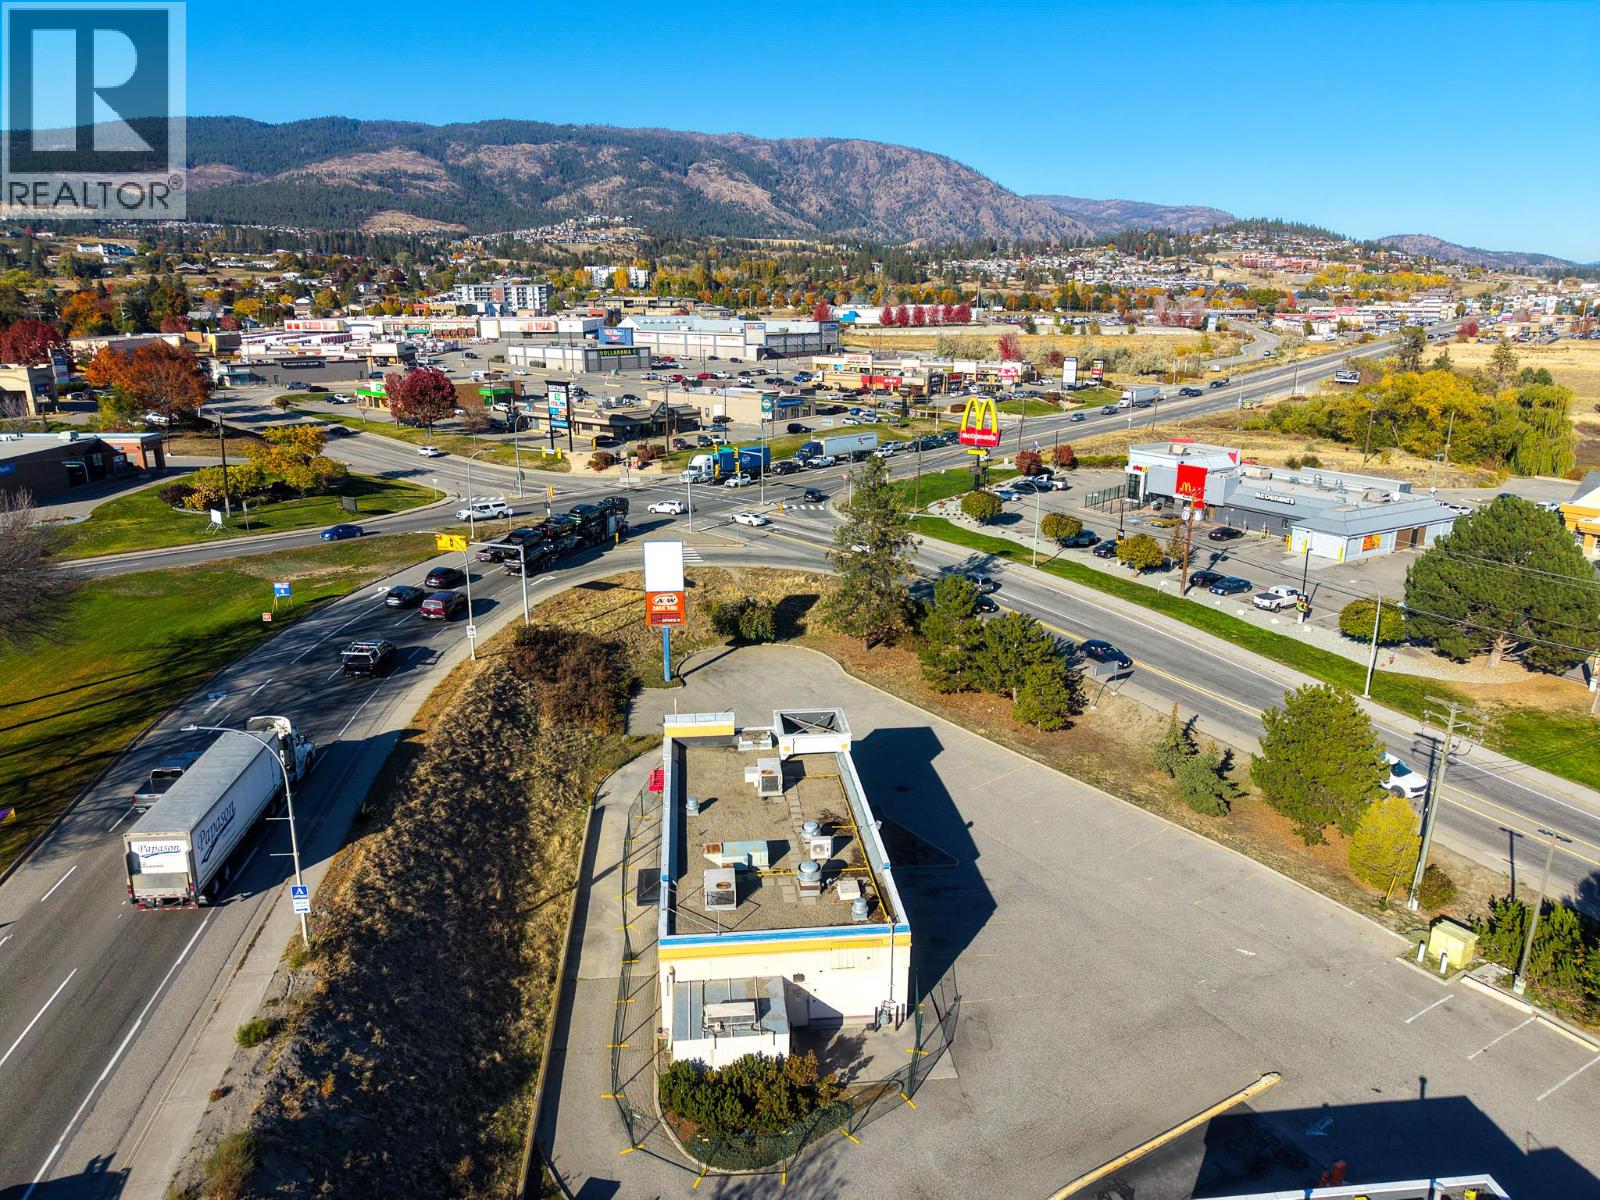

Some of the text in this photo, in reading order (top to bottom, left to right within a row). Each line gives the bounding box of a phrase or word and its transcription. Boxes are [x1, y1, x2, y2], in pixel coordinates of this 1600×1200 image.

[1254, 491, 1296, 505] McDonald's
[197, 800, 236, 850] Papason
[138, 844, 180, 853] Papason
